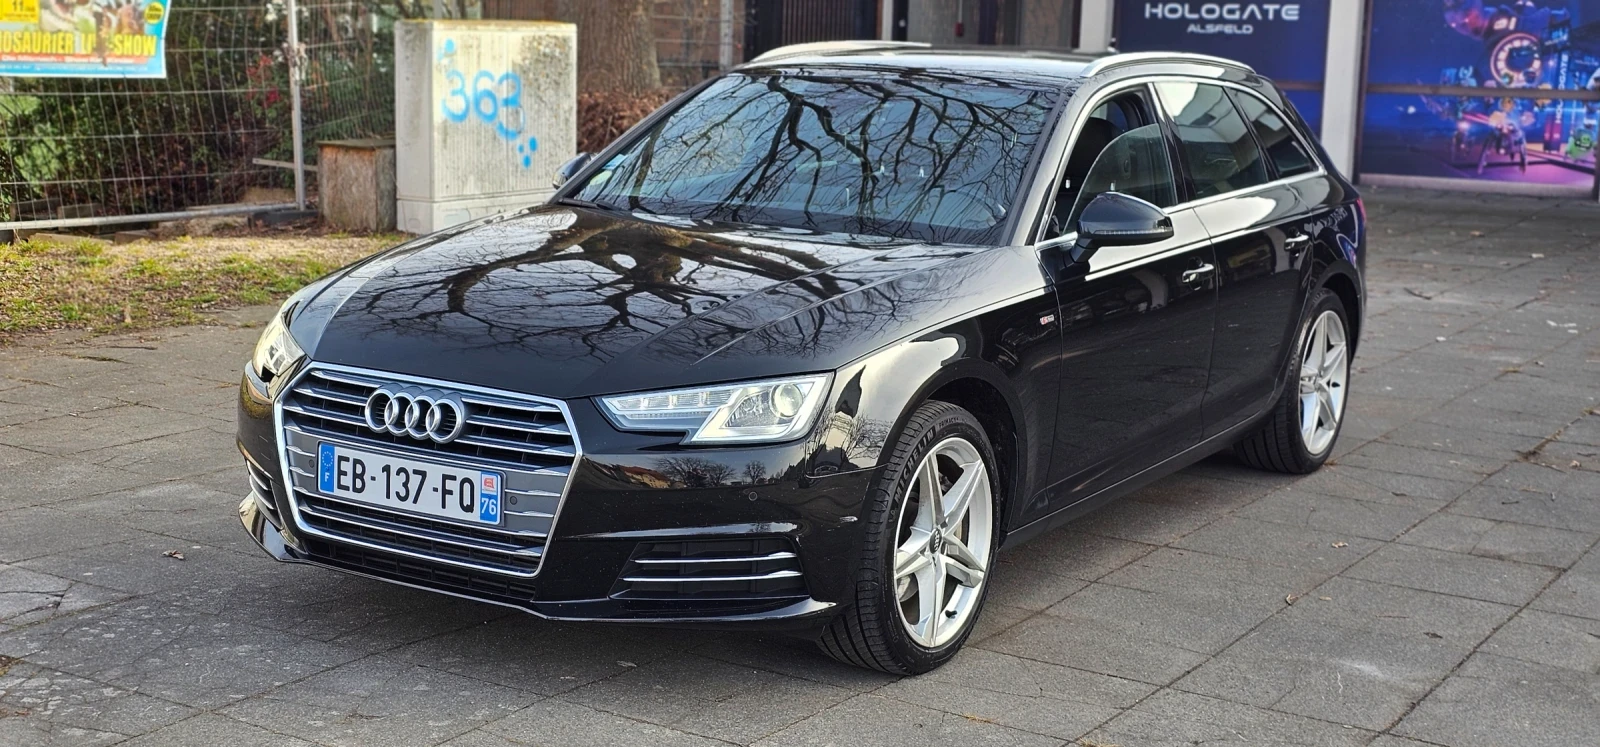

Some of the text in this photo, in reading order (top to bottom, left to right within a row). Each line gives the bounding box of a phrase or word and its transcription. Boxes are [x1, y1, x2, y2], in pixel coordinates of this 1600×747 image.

[1145, 3, 1300, 21] HOLOGATE
[1187, 24, 1254, 35] ALSFELD
[0, 31, 74, 54] OSAURIER
[895, 428, 935, 504] MICHELIN
[324, 472, 331, 483] F
[337, 454, 475, 514] EB-137-FQ
[481, 497, 497, 515] 76
